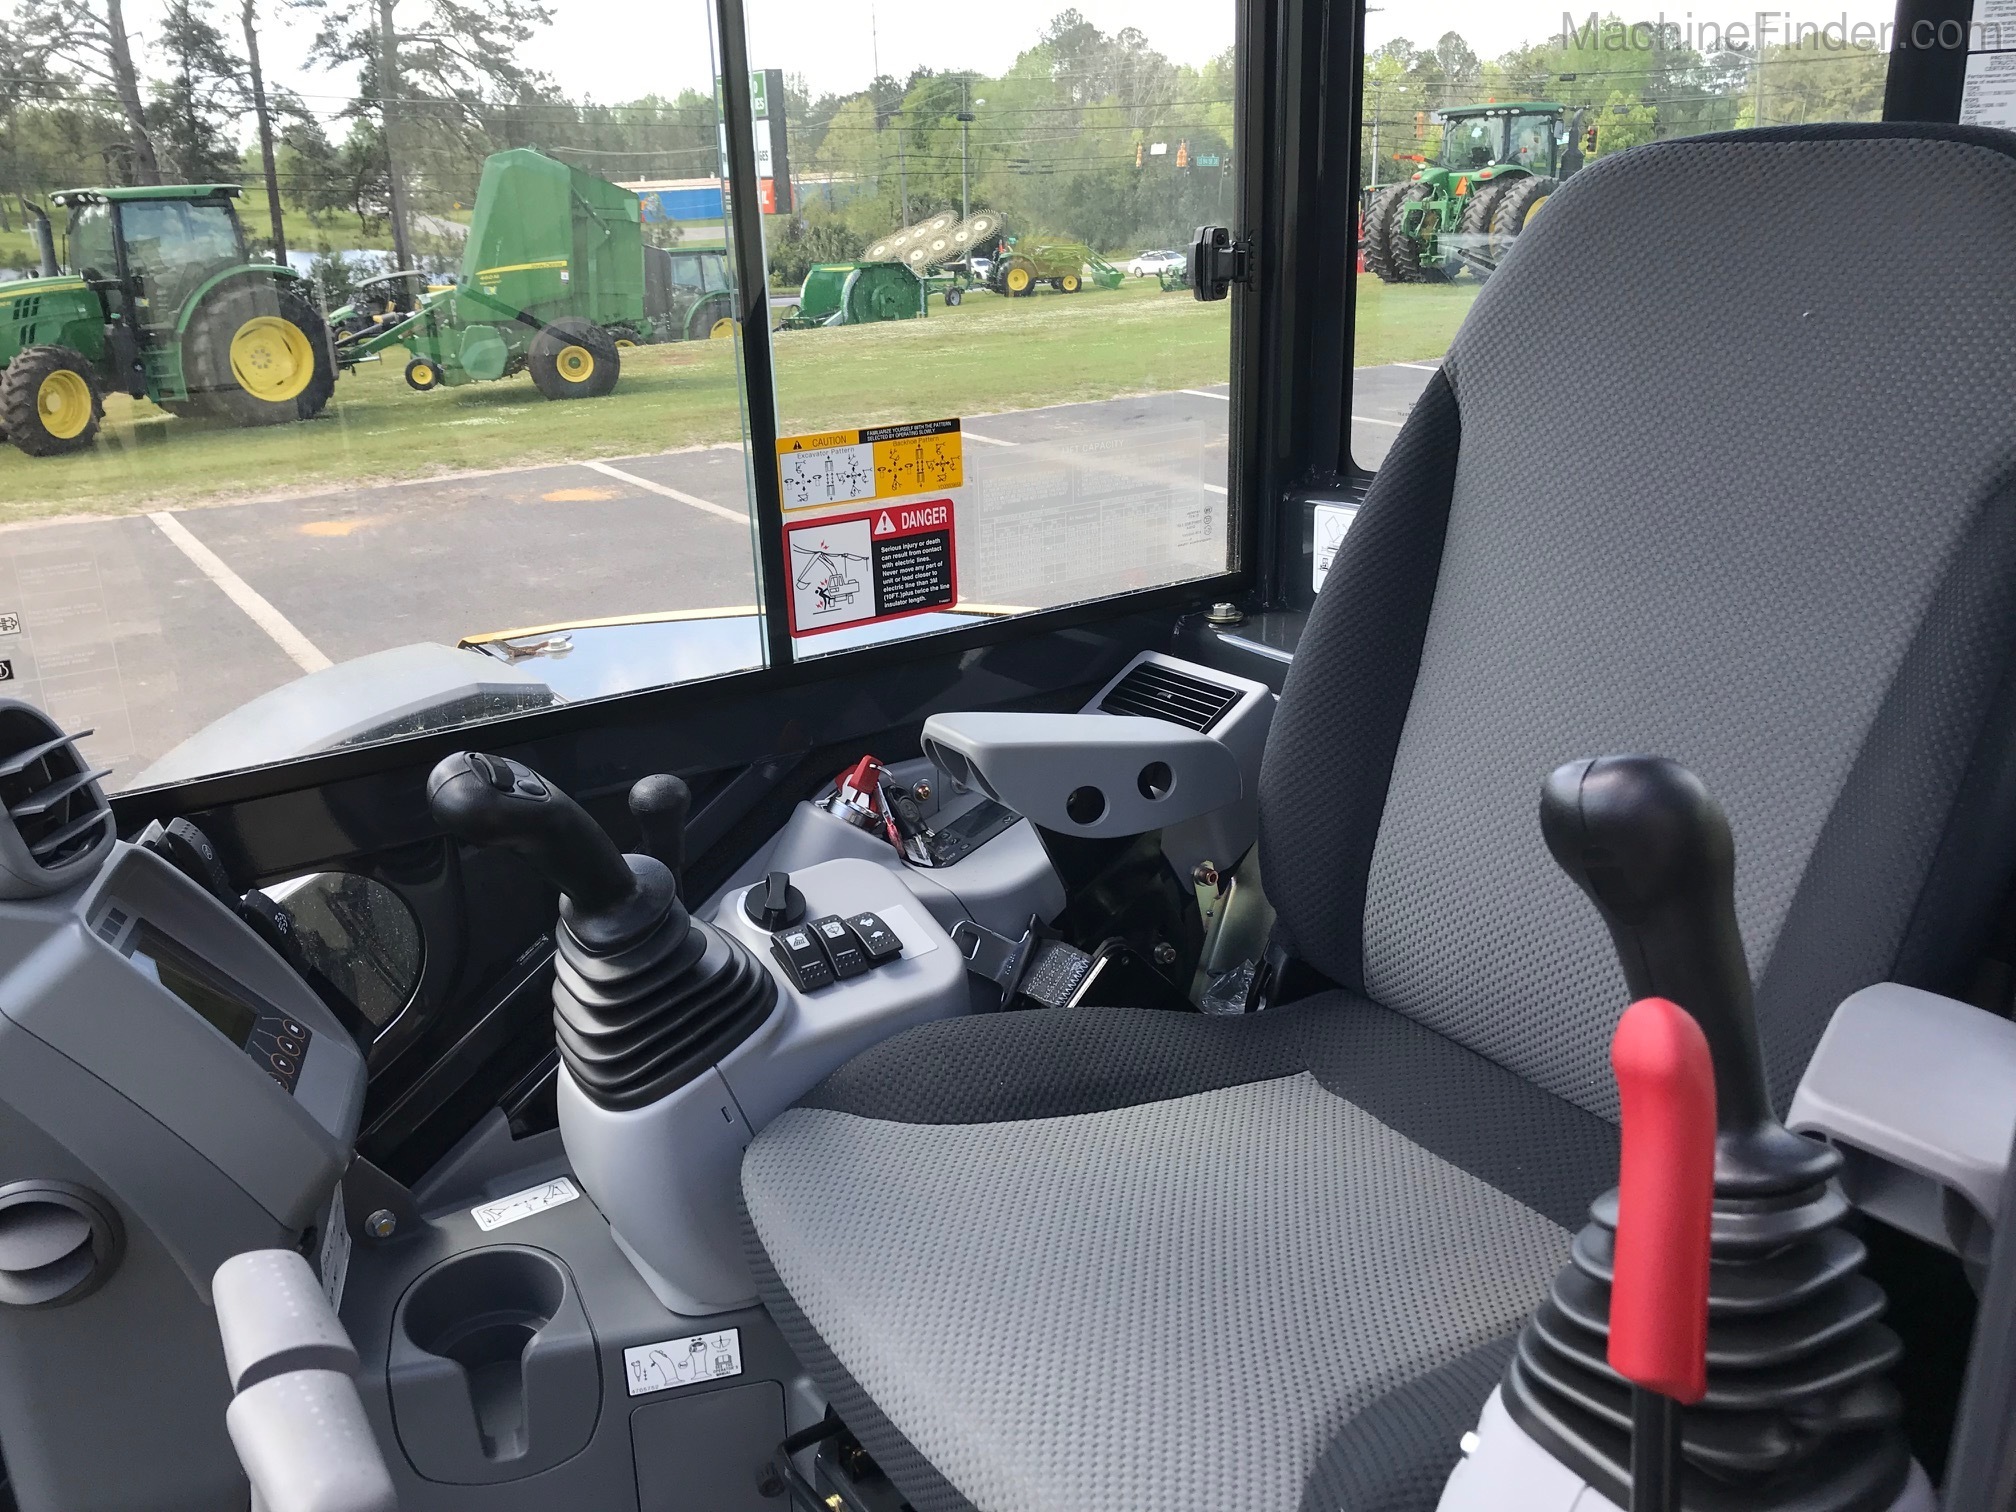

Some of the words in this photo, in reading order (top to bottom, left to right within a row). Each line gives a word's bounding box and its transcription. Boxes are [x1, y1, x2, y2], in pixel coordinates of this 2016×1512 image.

[866, 428, 892, 436] FAMILIARIZE
[892, 425, 915, 434] YOURSELF
[867, 433, 888, 442] SELECTED
[895, 430, 919, 438] OPERATING
[812, 435, 847, 448] CAUTION
[893, 438, 917, 447] Backhoe
[918, 436, 940, 444] Pattern
[1082, 439, 1124, 452] CAPACITY
[797, 450, 830, 459] Excavator
[830, 447, 855, 455] Pattern
[901, 506, 948, 530] DANGER
[881, 545, 901, 553] Serious
[903, 541, 918, 550] injury
[922, 545, 942, 554] contact
[883, 584, 904, 593] electric
[909, 596, 926, 604] length.
